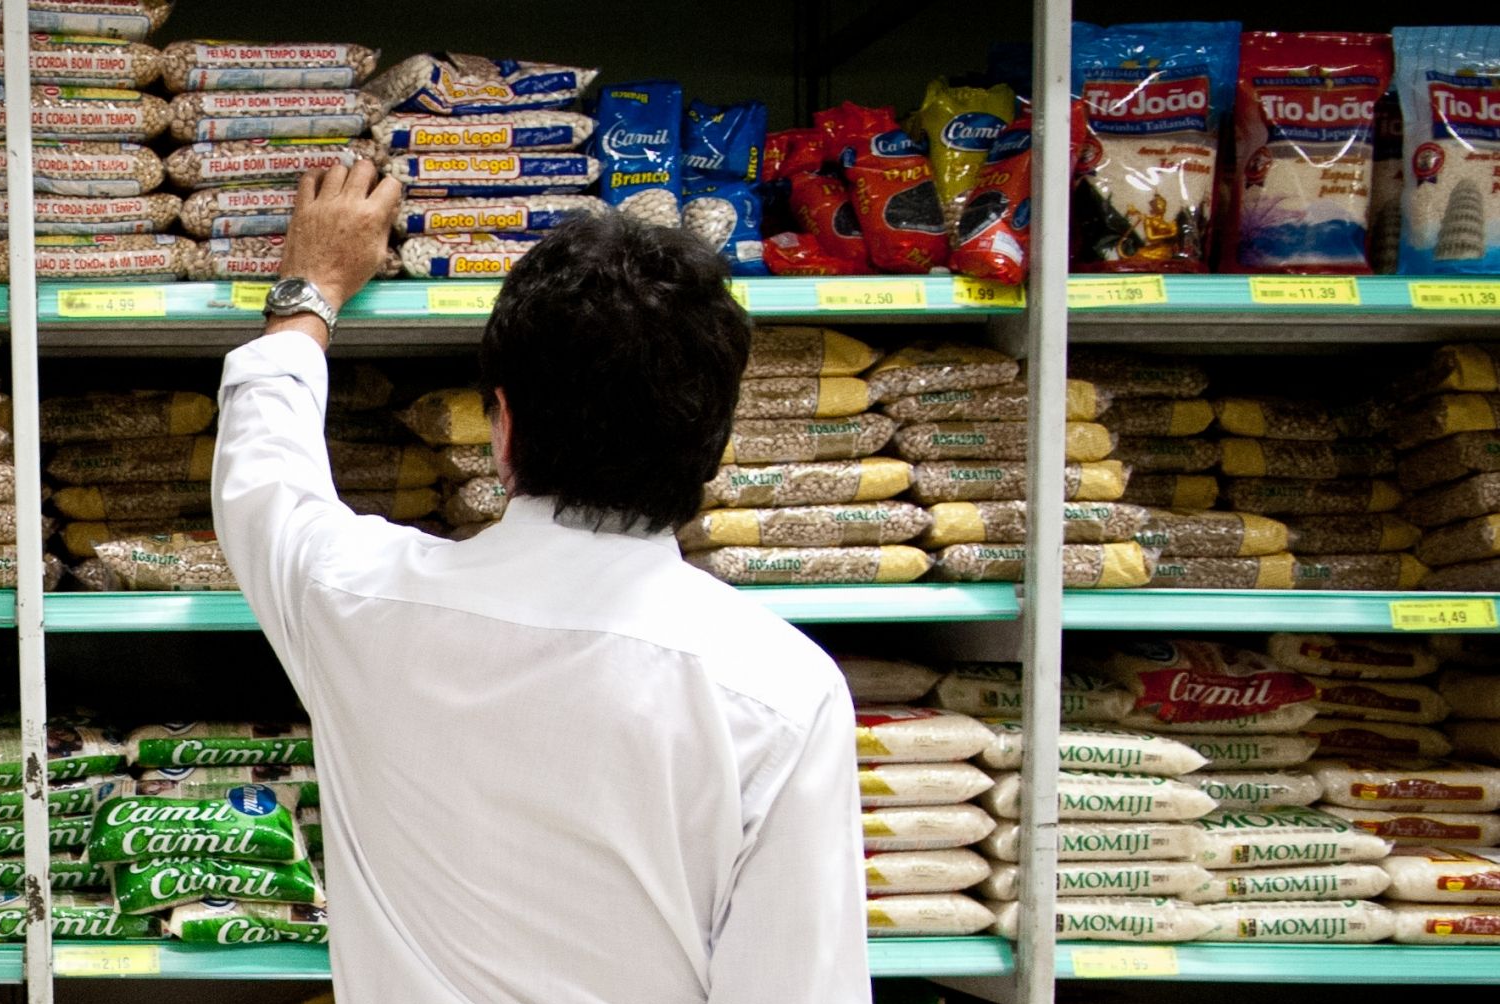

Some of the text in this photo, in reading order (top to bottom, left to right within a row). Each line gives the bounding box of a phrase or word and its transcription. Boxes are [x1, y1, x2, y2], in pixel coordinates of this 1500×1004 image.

[248, 97, 270, 107] BOM
[273, 97, 305, 107] TEMPO
[308, 96, 345, 106] RAJADO
[1087, 87, 1206, 118] Tio João
[1261, 95, 1376, 122] Tio João
[1433, 90, 1473, 118] Tio
[32, 112, 137, 125] DE CORDA BOM TEMPO
[415, 129, 460, 145] Broto
[463, 127, 508, 147] Legal
[610, 128, 669, 149] Camil
[948, 121, 1007, 141] Cami
[424, 156, 514, 175] Broto Legal
[611, 169, 669, 188] Branco
[430, 210, 522, 230] Broto Legal
[1170, 672, 1274, 709] Camil
[107, 801, 234, 827] Camil
[1064, 795, 1153, 816] MOMIJI
[123, 827, 259, 855] Camil
[1251, 843, 1339, 864] MOMIJI
[1068, 914, 1155, 936] MOMIJI
[1260, 918, 1348, 940] MOMIJI
